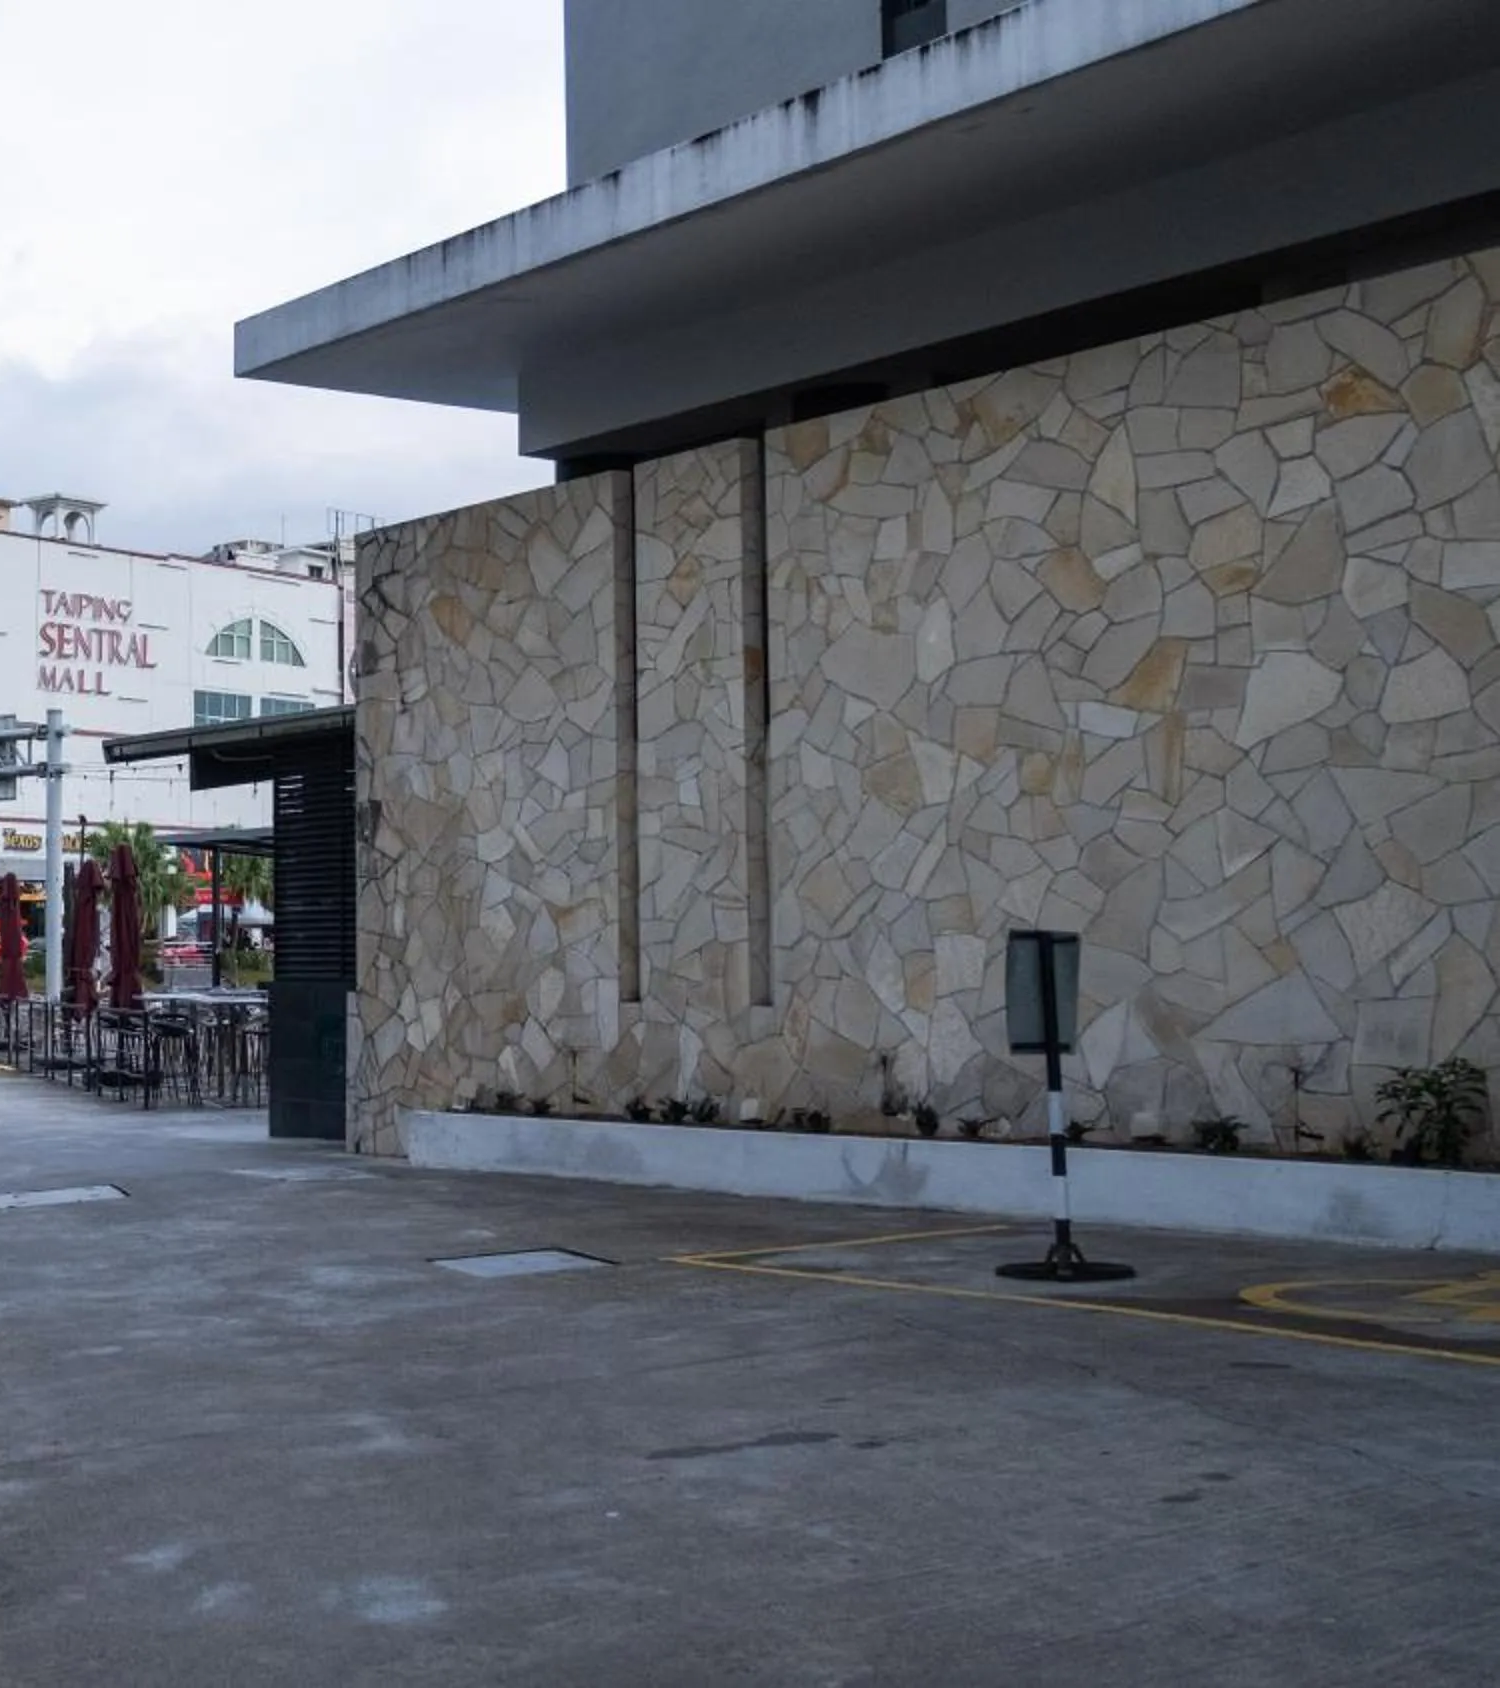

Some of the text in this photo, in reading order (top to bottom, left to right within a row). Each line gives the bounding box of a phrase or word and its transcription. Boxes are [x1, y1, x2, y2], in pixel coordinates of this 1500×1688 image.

[40, 589, 132, 623] TAIPING
[39, 621, 157, 669] SENTRAL
[37, 665, 112, 696] MALL
